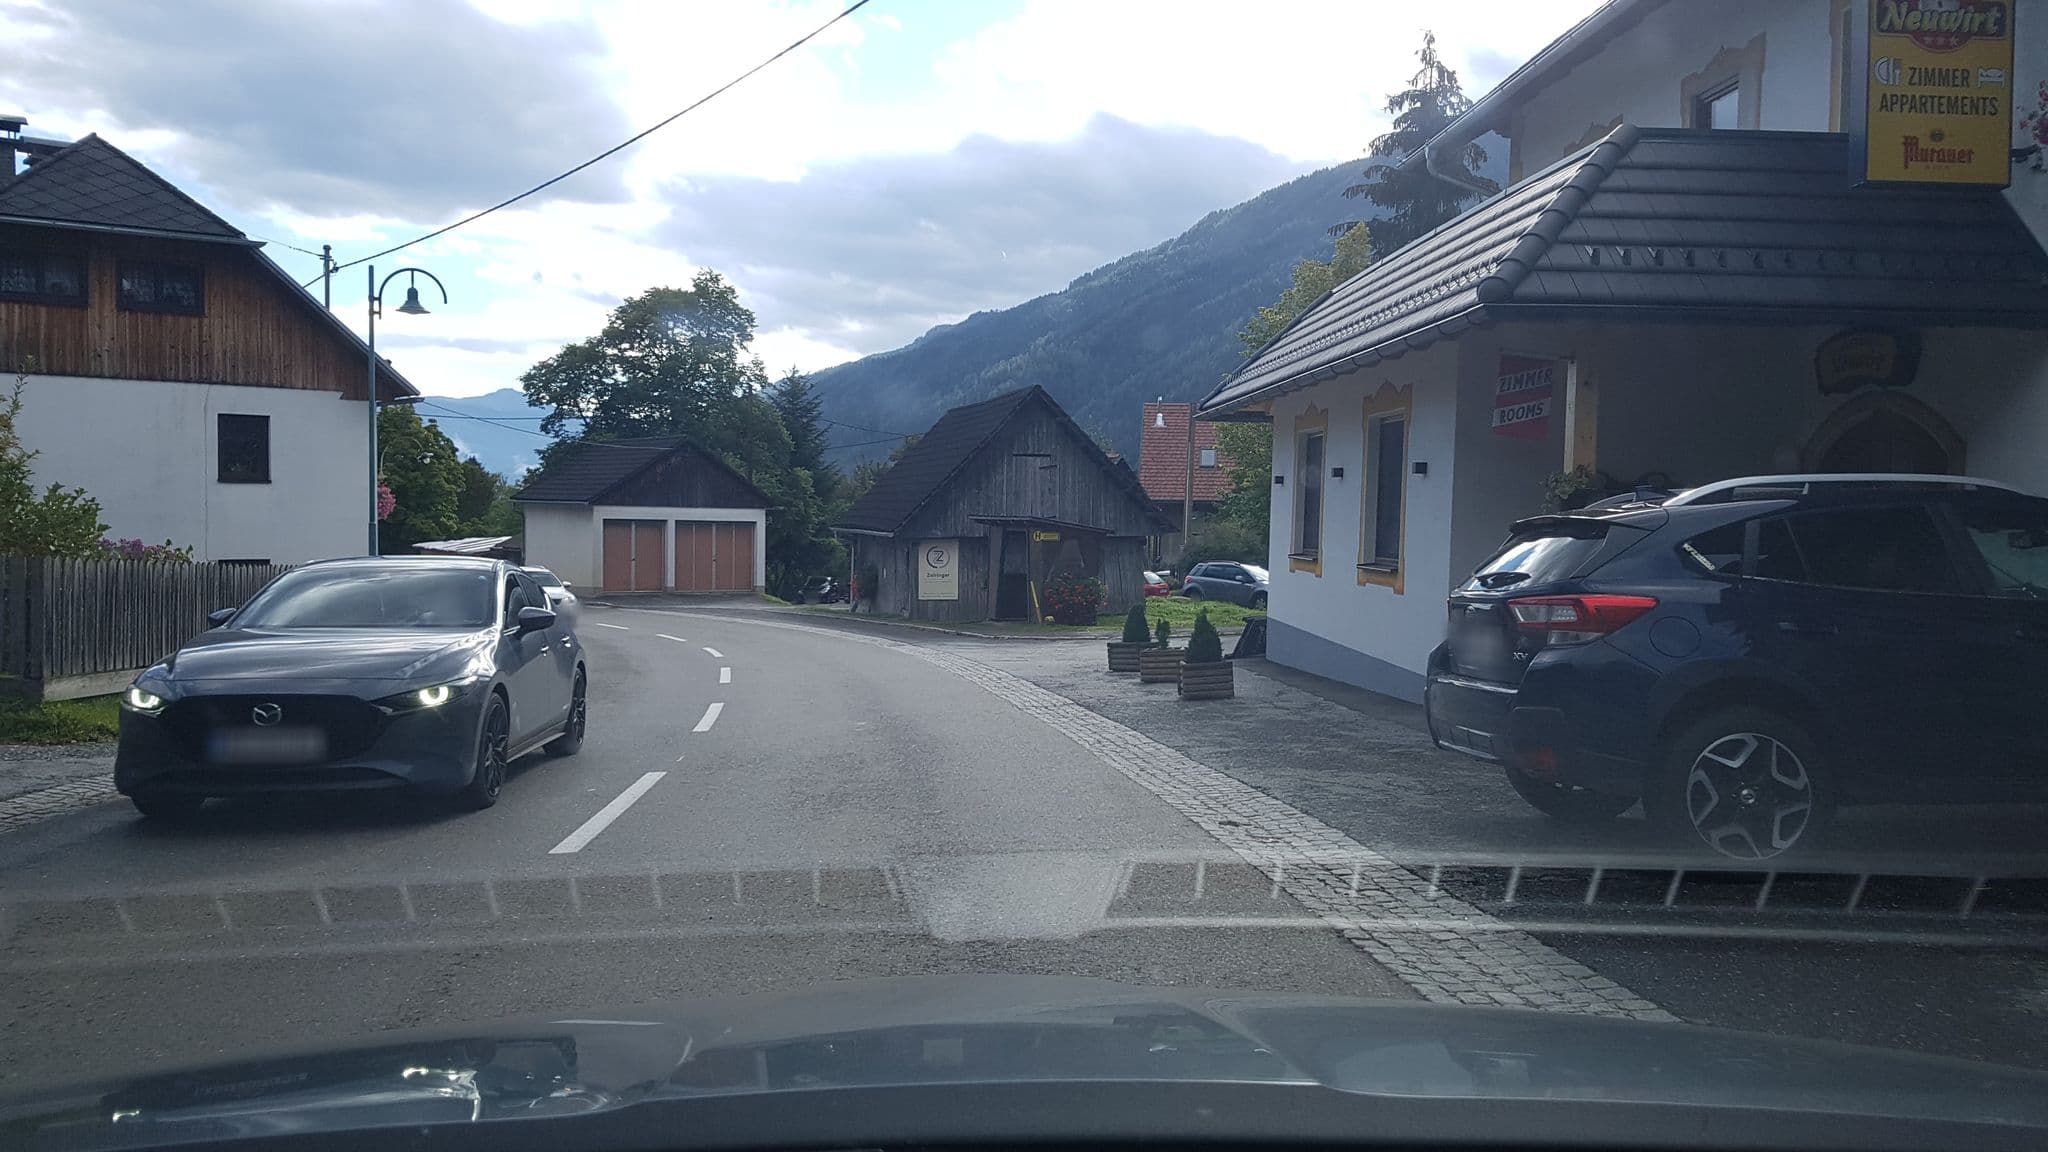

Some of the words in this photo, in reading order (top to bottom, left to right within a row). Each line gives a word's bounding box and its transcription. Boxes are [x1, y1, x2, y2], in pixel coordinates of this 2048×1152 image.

[1880, 1, 2002, 34] Neuwirt
[1908, 66, 1971, 88] ZIMMER
[1879, 93, 1999, 116] APPARTEMENTS
[1903, 135, 1974, 169] Murauer
[1498, 367, 1553, 393] ZIMMER
[1499, 402, 1545, 424] ROOMS
